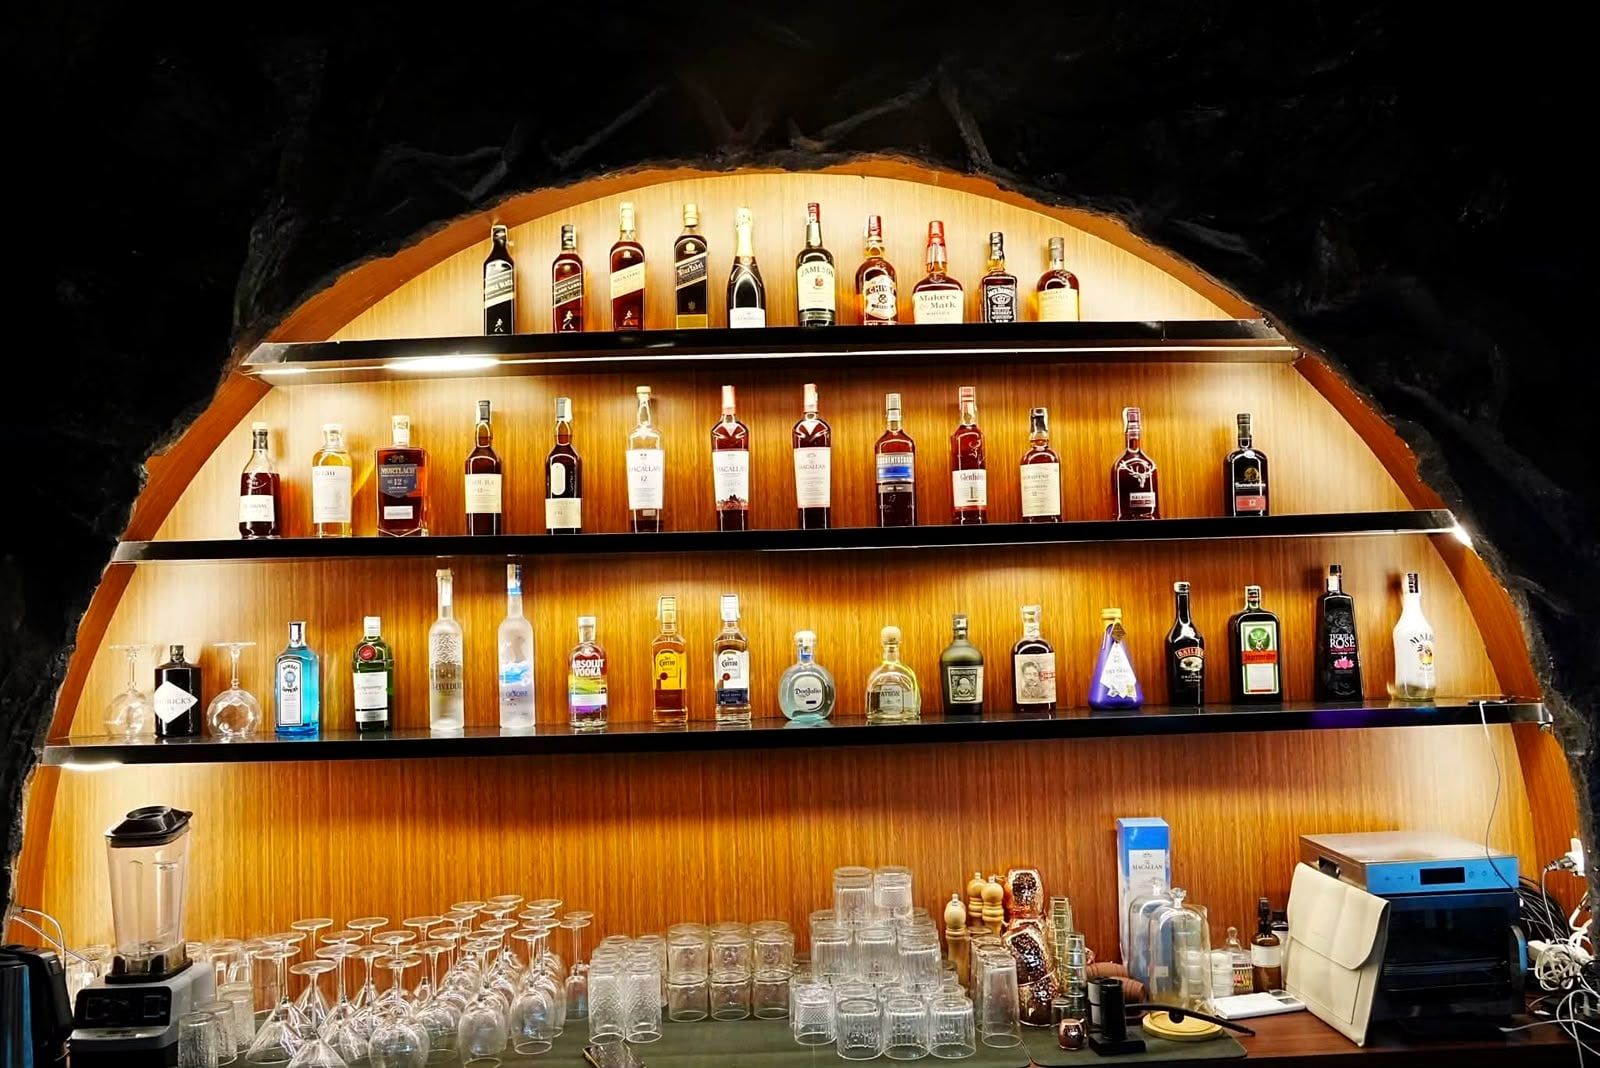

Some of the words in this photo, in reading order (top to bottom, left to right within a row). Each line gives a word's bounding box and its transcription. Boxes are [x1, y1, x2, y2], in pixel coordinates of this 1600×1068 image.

[800, 264, 834, 278] JAMESON
[1329, 638, 1356, 648] ROSE
[572, 659, 605, 668] ABSOLUT
[574, 667, 602, 677] VODKA
